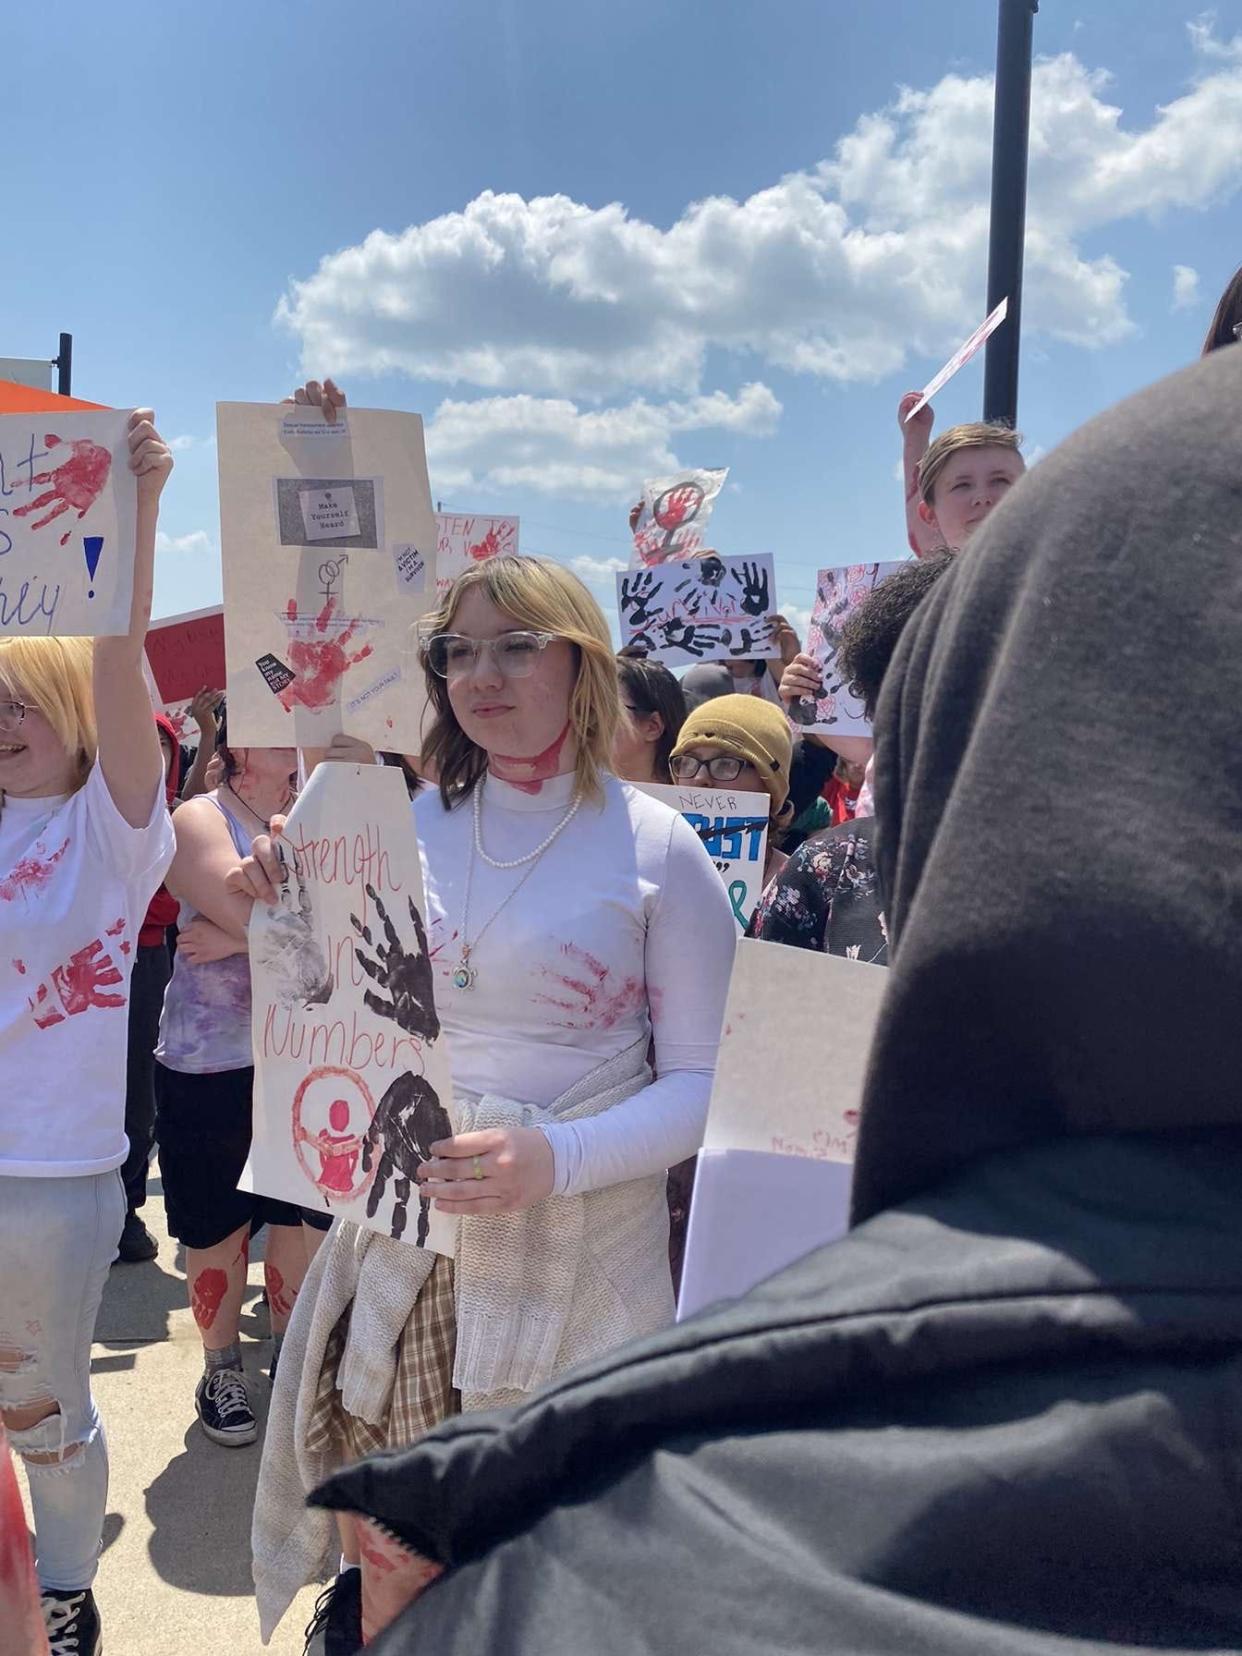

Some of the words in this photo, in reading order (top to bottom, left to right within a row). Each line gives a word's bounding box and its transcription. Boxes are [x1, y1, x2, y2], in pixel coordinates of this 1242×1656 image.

[310, 510, 349, 520] Yourself
[400, 549, 420, 568] VICTIM
[679, 793, 737, 810] NEVER
[263, 1003, 425, 1077] Numbers
